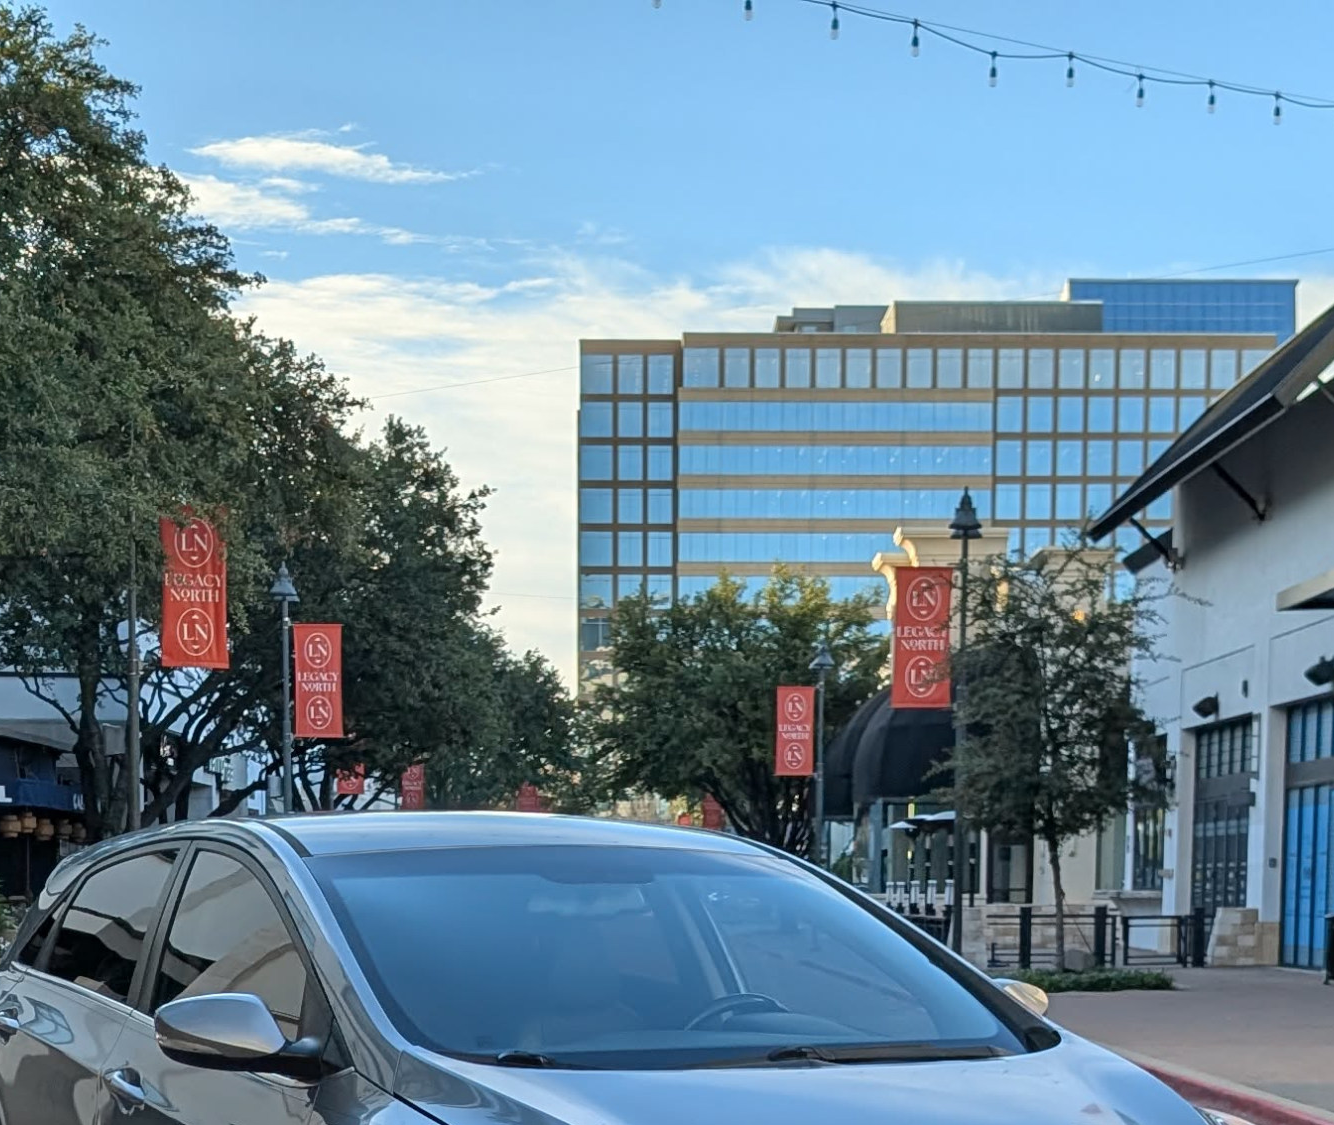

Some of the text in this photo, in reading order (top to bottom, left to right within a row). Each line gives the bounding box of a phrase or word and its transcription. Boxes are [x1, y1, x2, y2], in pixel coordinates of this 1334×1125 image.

[181, 531, 208, 552] LN
[164, 573, 223, 588] LEGACY
[170, 588, 219, 603] NORTH
[183, 623, 208, 641] LN
[309, 643, 328, 658] LN
[901, 639, 945, 651] NORTH
[298, 671, 339, 682] LEGACY
[302, 682, 337, 692] NORTH
[310, 706, 329, 719] LN
